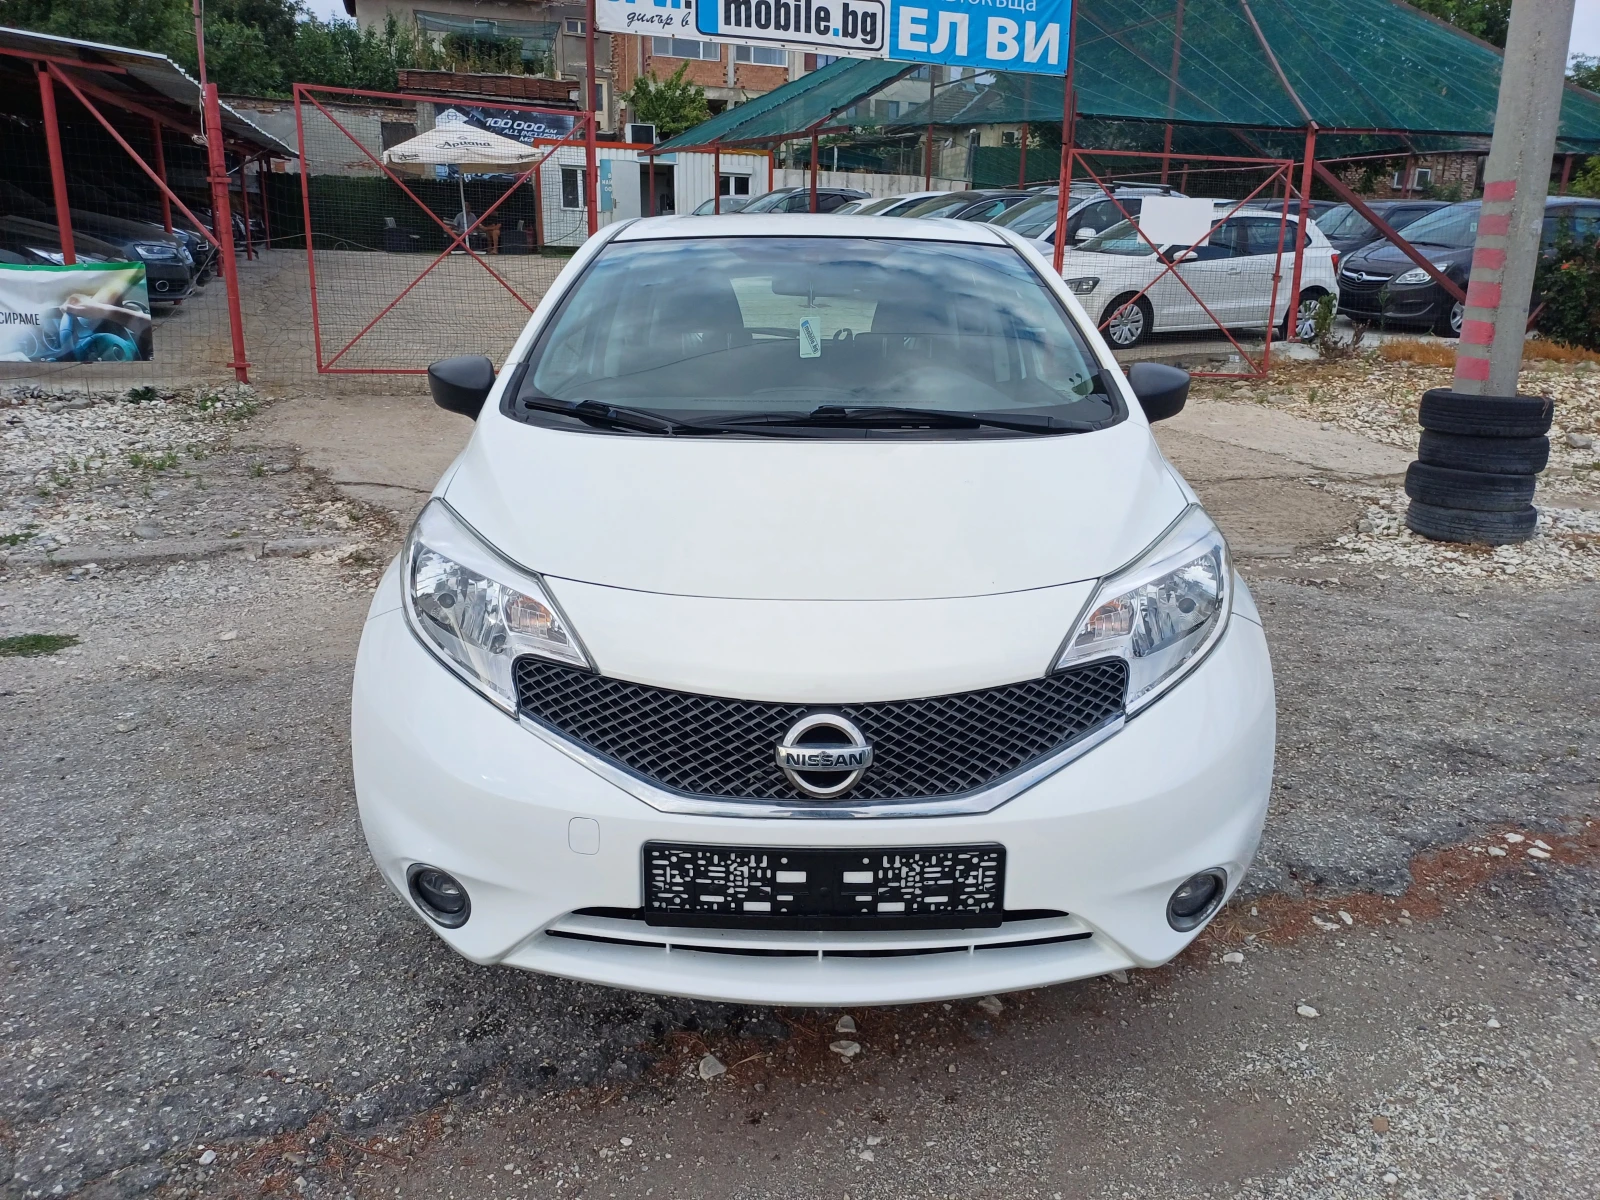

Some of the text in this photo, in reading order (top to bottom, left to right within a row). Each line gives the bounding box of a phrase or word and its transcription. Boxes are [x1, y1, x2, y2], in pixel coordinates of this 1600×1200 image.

[627, 12, 674, 29] дилър
[724, 0, 877, 45] mobile.bg
[897, 6, 1060, 66] ЕЛ ВИ
[485, 117, 512, 128] 100
[513, 119, 545, 132] 000
[502, 128, 520, 136] ALL
[785, 752, 863, 767] NISSAN
